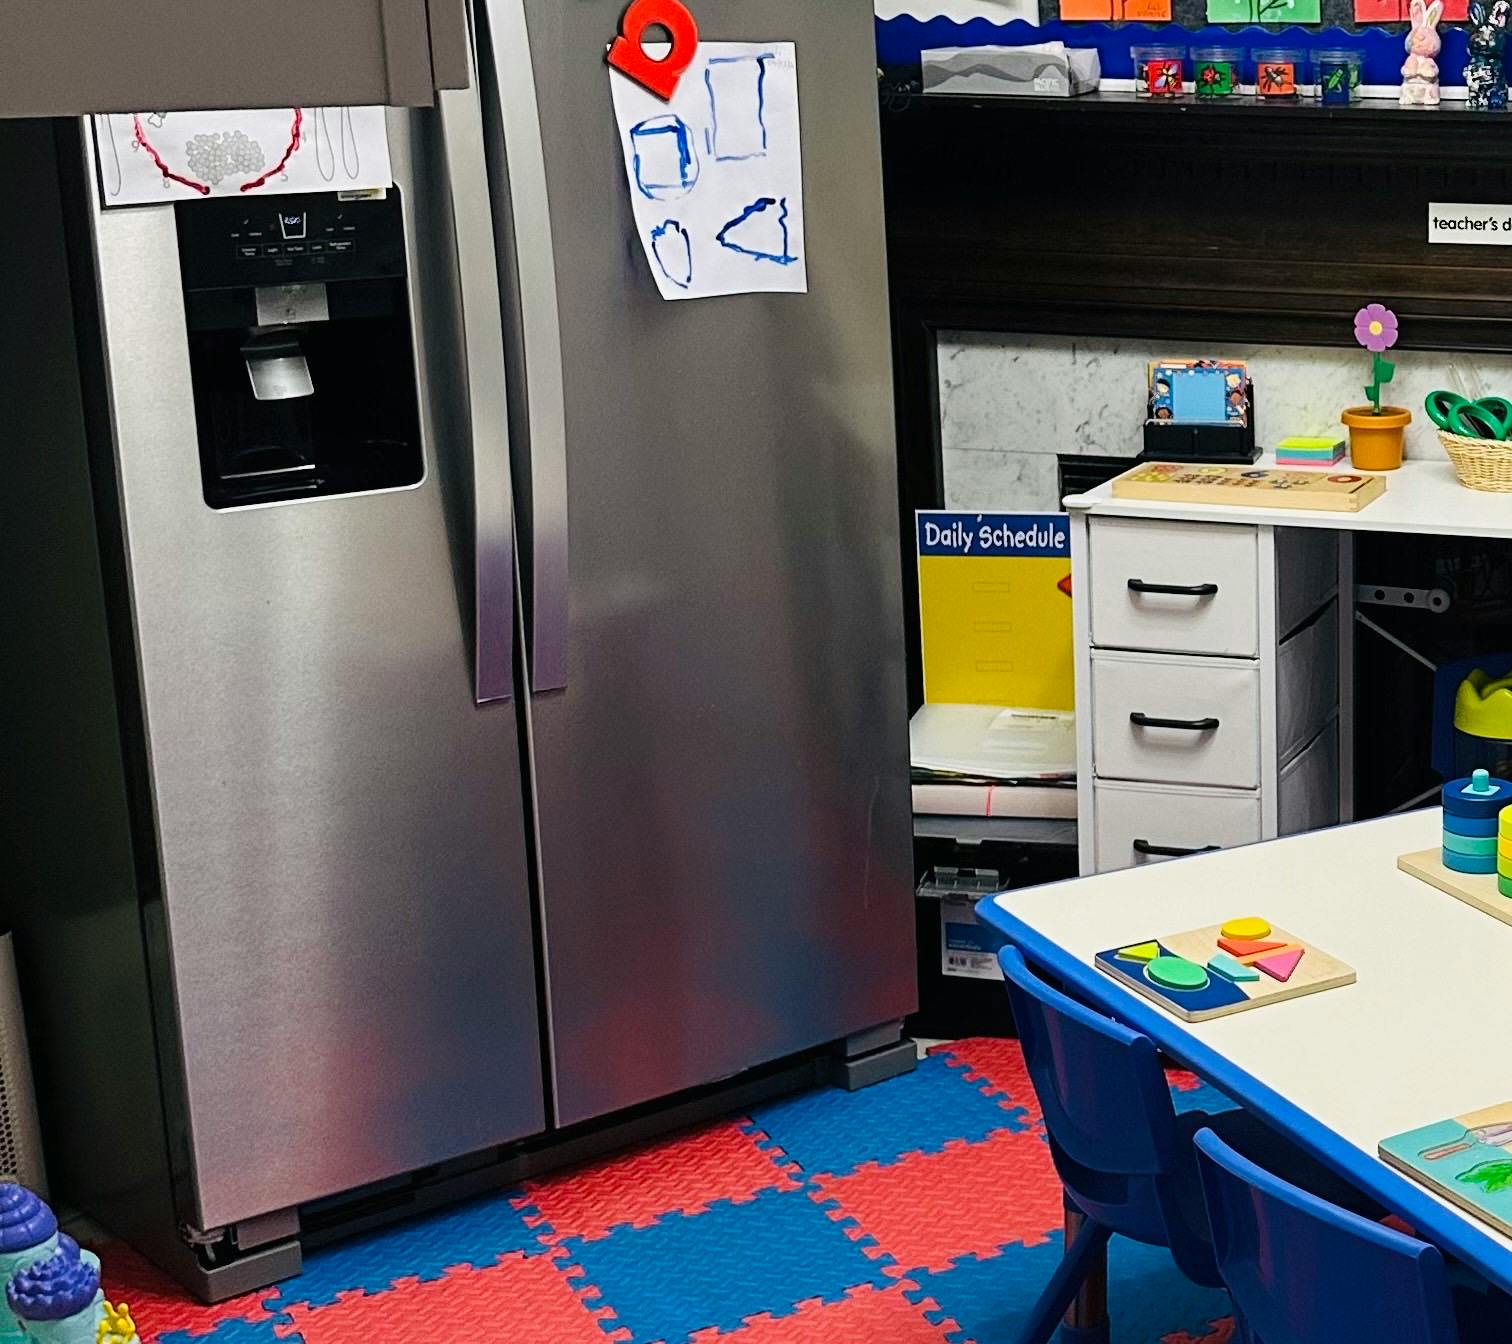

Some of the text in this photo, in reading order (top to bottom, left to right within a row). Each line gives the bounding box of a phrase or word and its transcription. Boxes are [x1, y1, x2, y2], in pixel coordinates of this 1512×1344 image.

[1433, 217, 1498, 232] teacher's
[925, 521, 1066, 553] Daily Schedule
